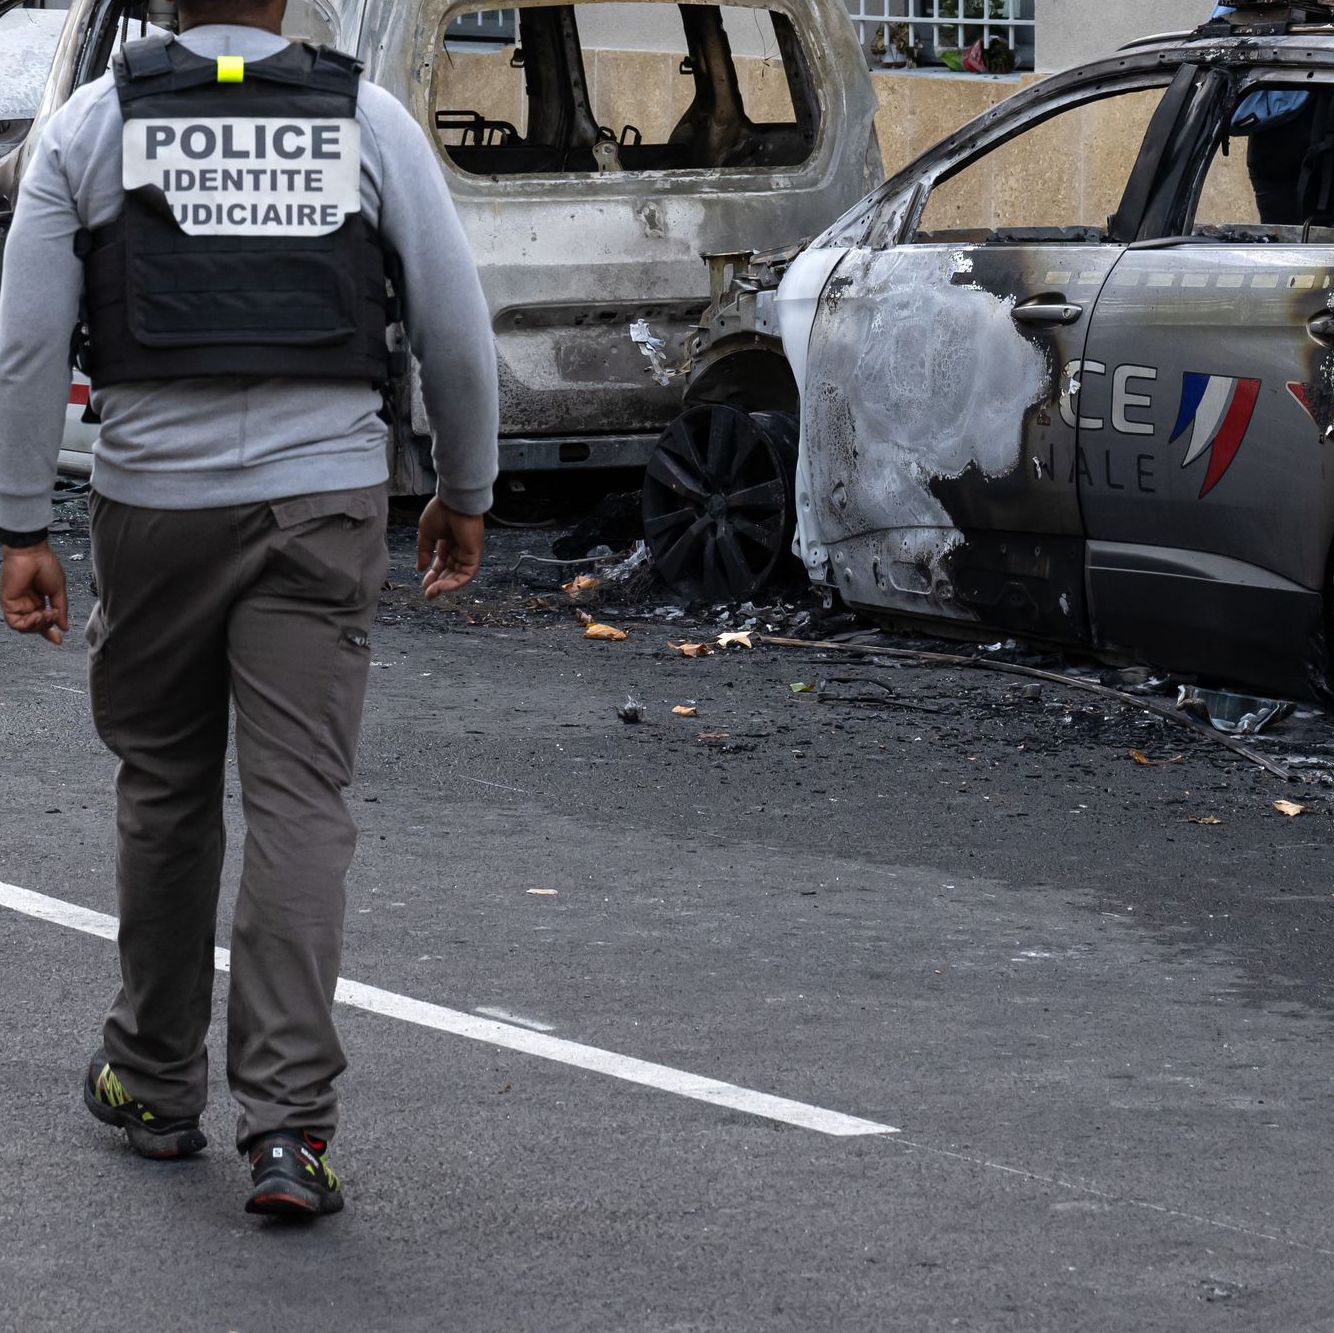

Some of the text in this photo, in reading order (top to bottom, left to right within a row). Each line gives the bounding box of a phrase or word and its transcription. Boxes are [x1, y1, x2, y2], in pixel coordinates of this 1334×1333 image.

[145, 124, 342, 160] POLICE
[162, 169, 324, 192] IDENTITE
[171, 203, 339, 226] UDICIAIRE
